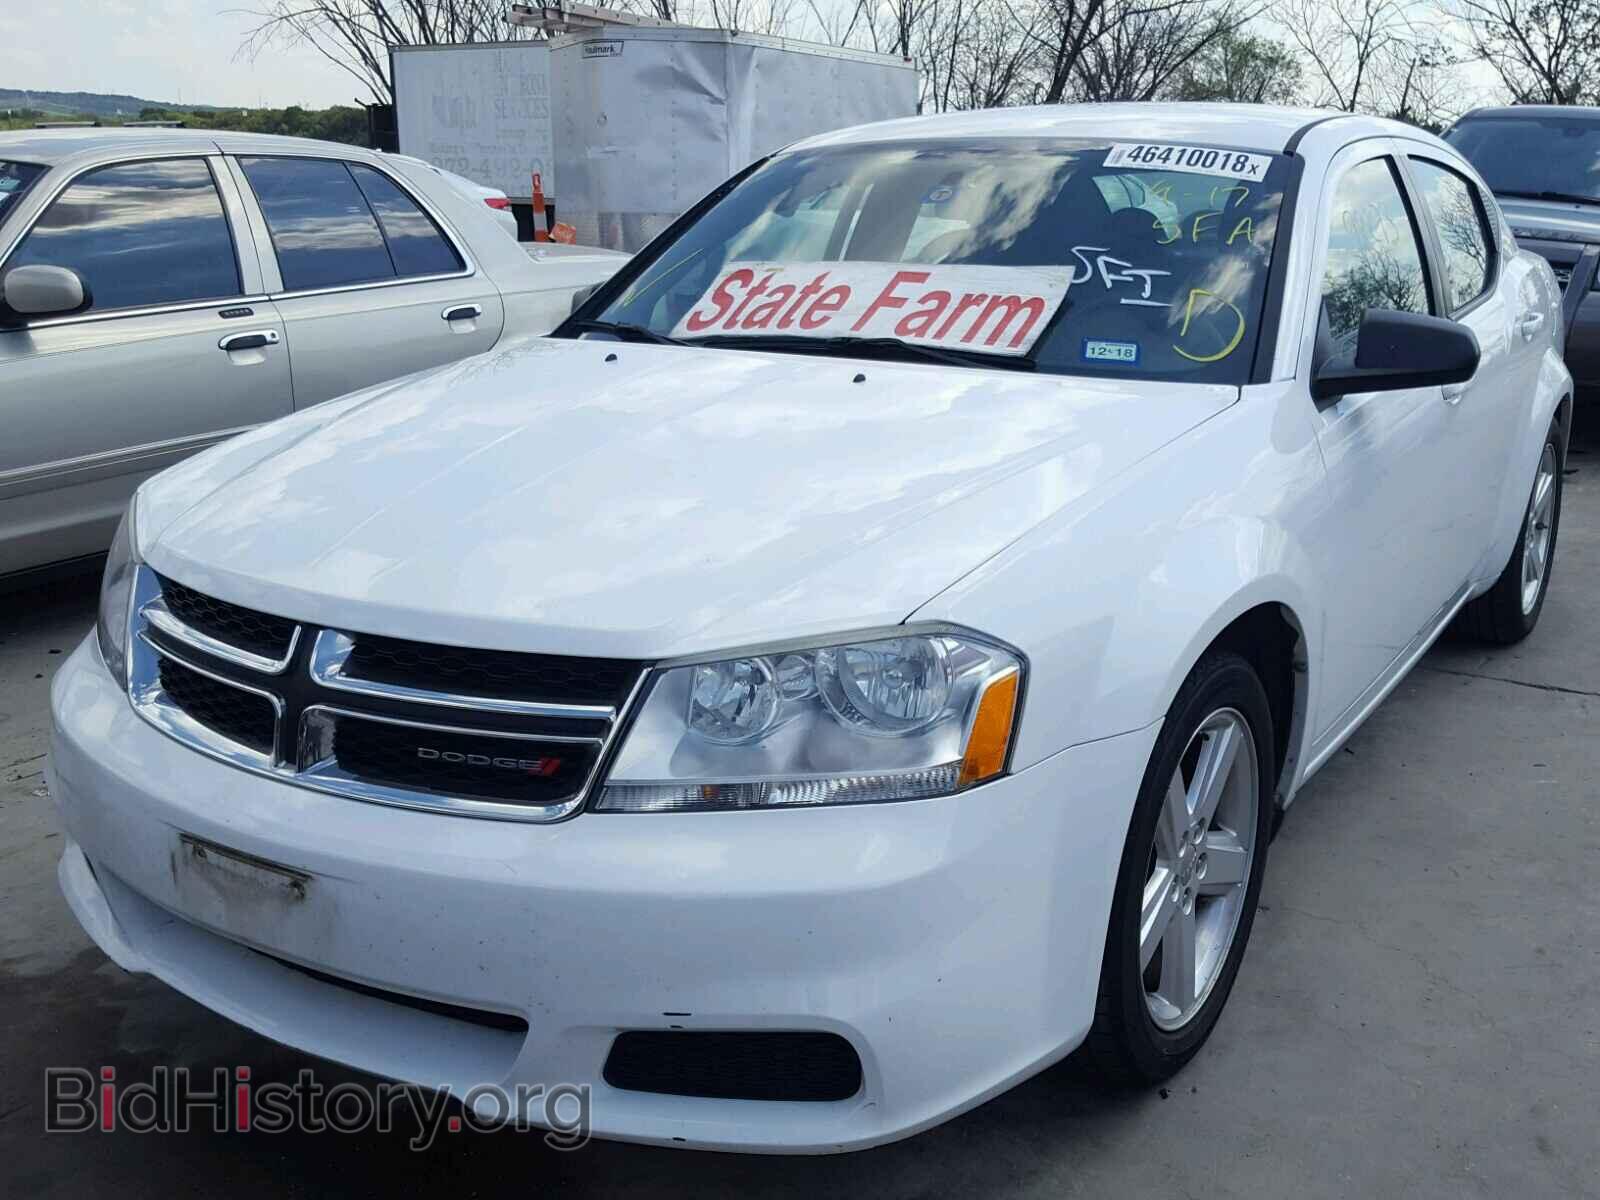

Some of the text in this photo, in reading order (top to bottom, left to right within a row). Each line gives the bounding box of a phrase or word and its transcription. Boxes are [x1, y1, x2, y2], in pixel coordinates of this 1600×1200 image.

[686, 268, 1046, 349] State Farm
[1172, 288, 1246, 363] D
[417, 747, 543, 771] DODGE
